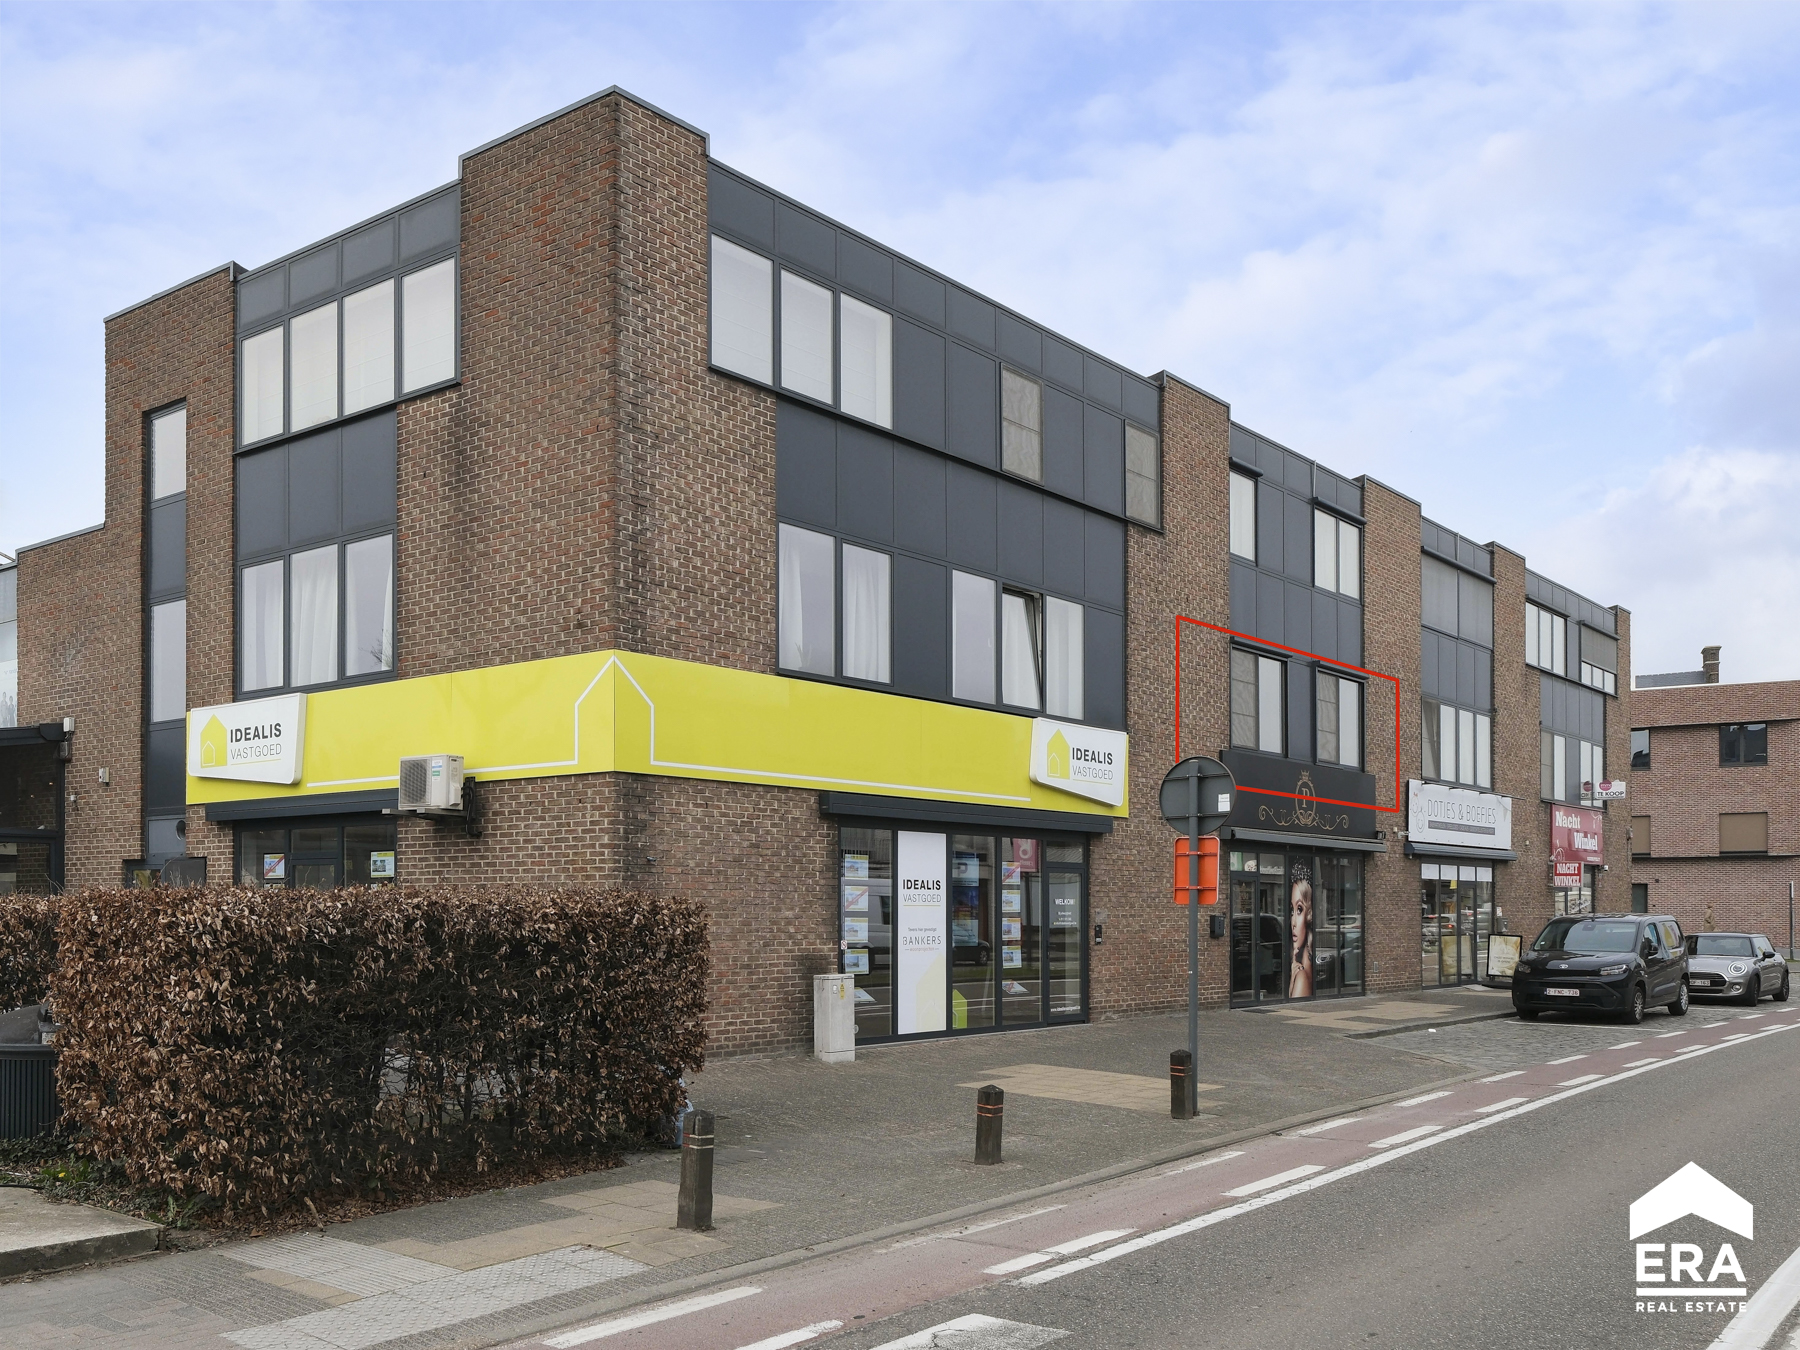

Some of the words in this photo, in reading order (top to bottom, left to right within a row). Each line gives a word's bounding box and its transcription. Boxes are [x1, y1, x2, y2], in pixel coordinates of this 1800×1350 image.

[230, 722, 282, 743] IDEALIS
[230, 743, 282, 760] VASTGOED
[1072, 747, 1113, 766] IDEALIS
[1072, 765, 1114, 781] VASTGOED
[1427, 799, 1456, 820] DOTJES
[1458, 803, 1464, 821] &
[1466, 804, 1497, 825] BOEFJES
[1555, 811, 1581, 829] Nacht
[1573, 831, 1598, 851] Winkel
[1556, 863, 1579, 874] NACHT
[902, 879, 941, 890] IDEALIS
[1554, 875, 1581, 887] WINKEL
[902, 893, 942, 903] VASTGOED
[902, 936, 942, 946] BANKERS
